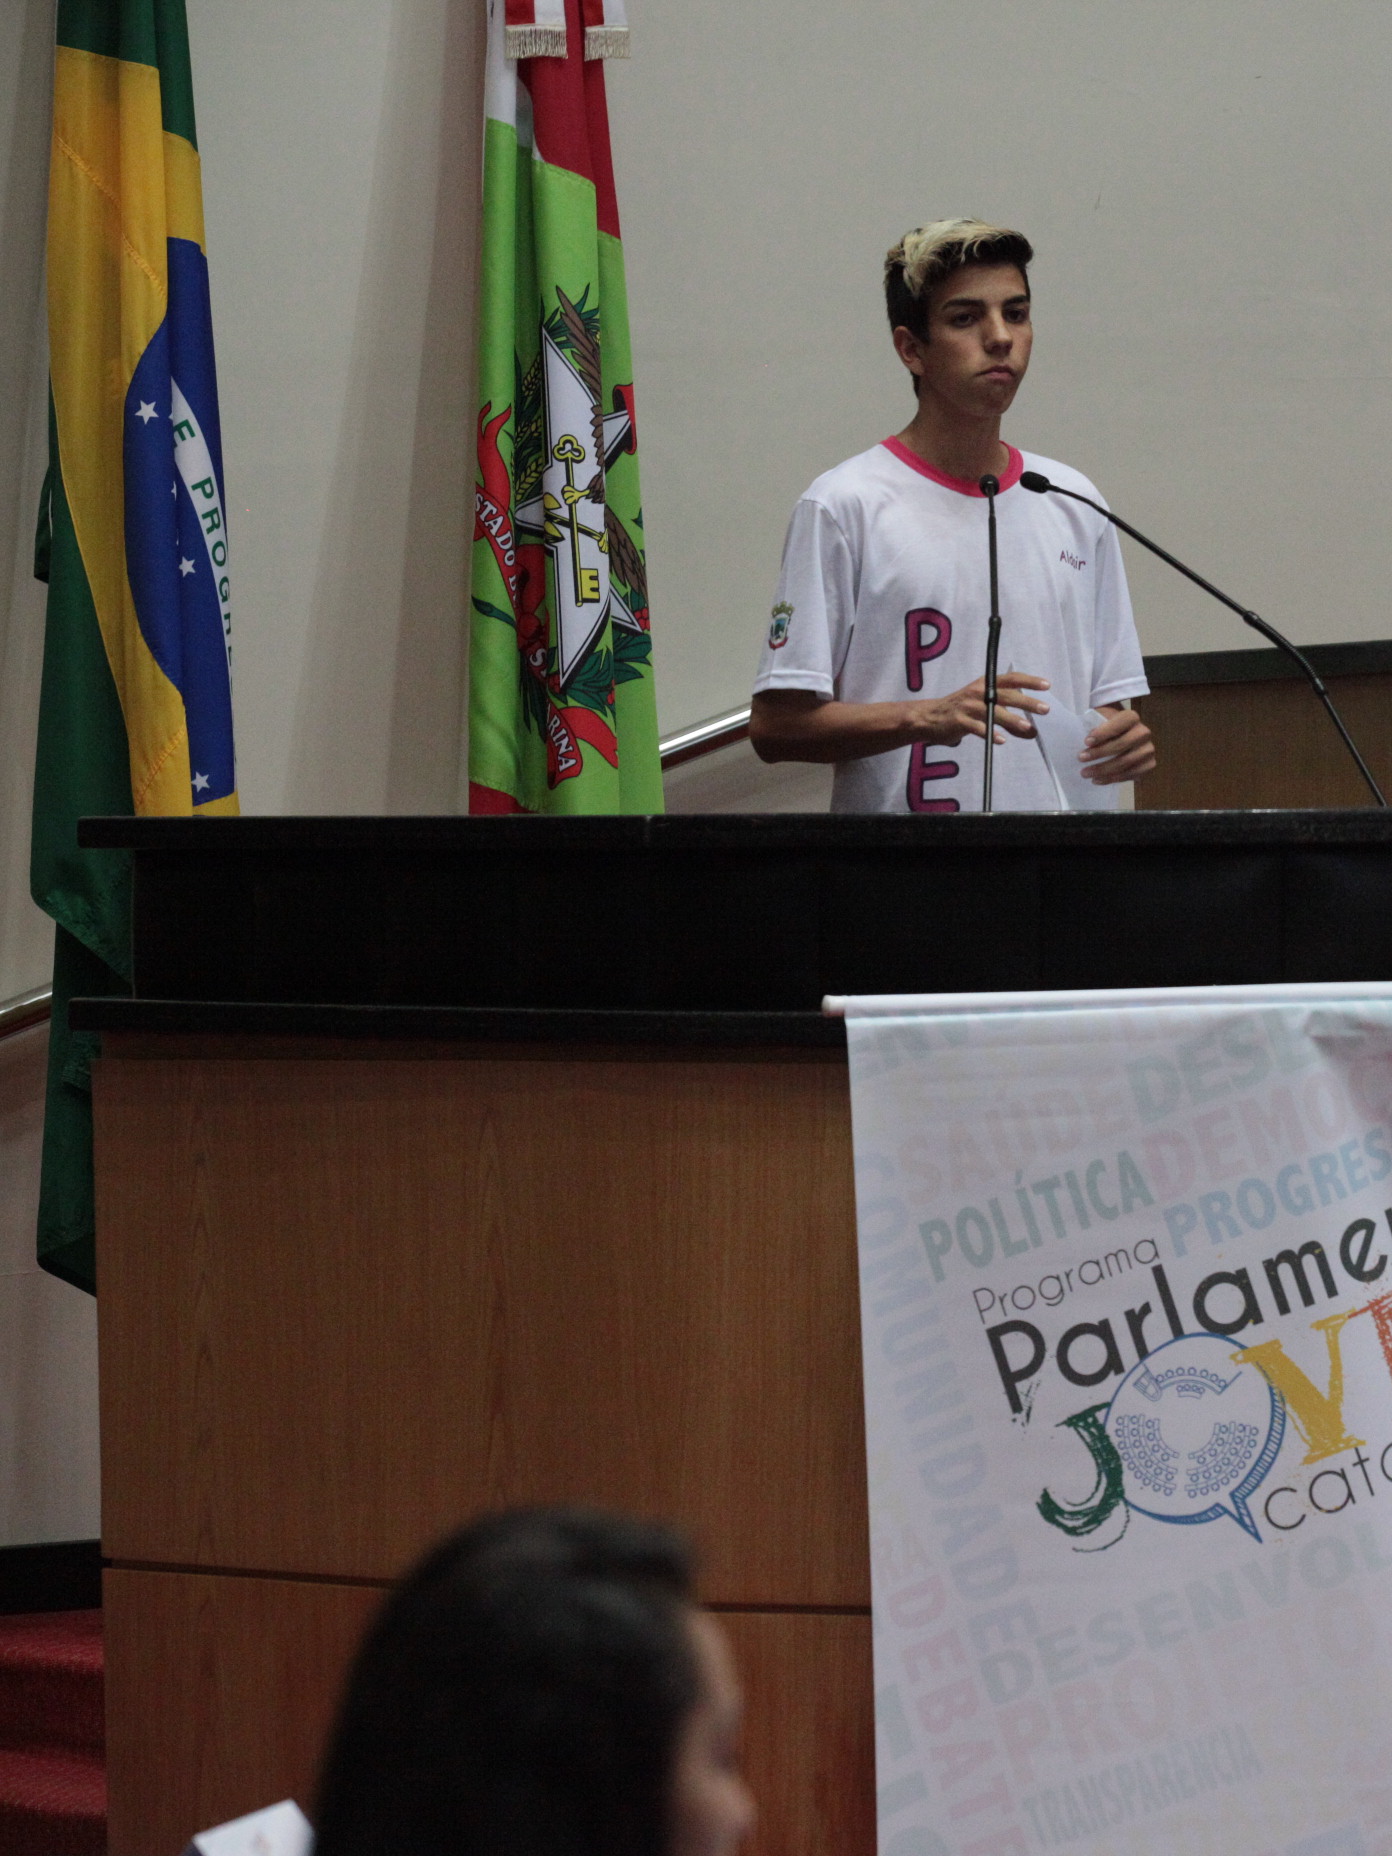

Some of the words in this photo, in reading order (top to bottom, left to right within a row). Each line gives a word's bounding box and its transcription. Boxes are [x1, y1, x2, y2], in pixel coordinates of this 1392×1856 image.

[547, 703, 578, 773] RINA
[918, 1149, 1154, 1283] POLÍTICA
[972, 1236, 1161, 1325] Programa
